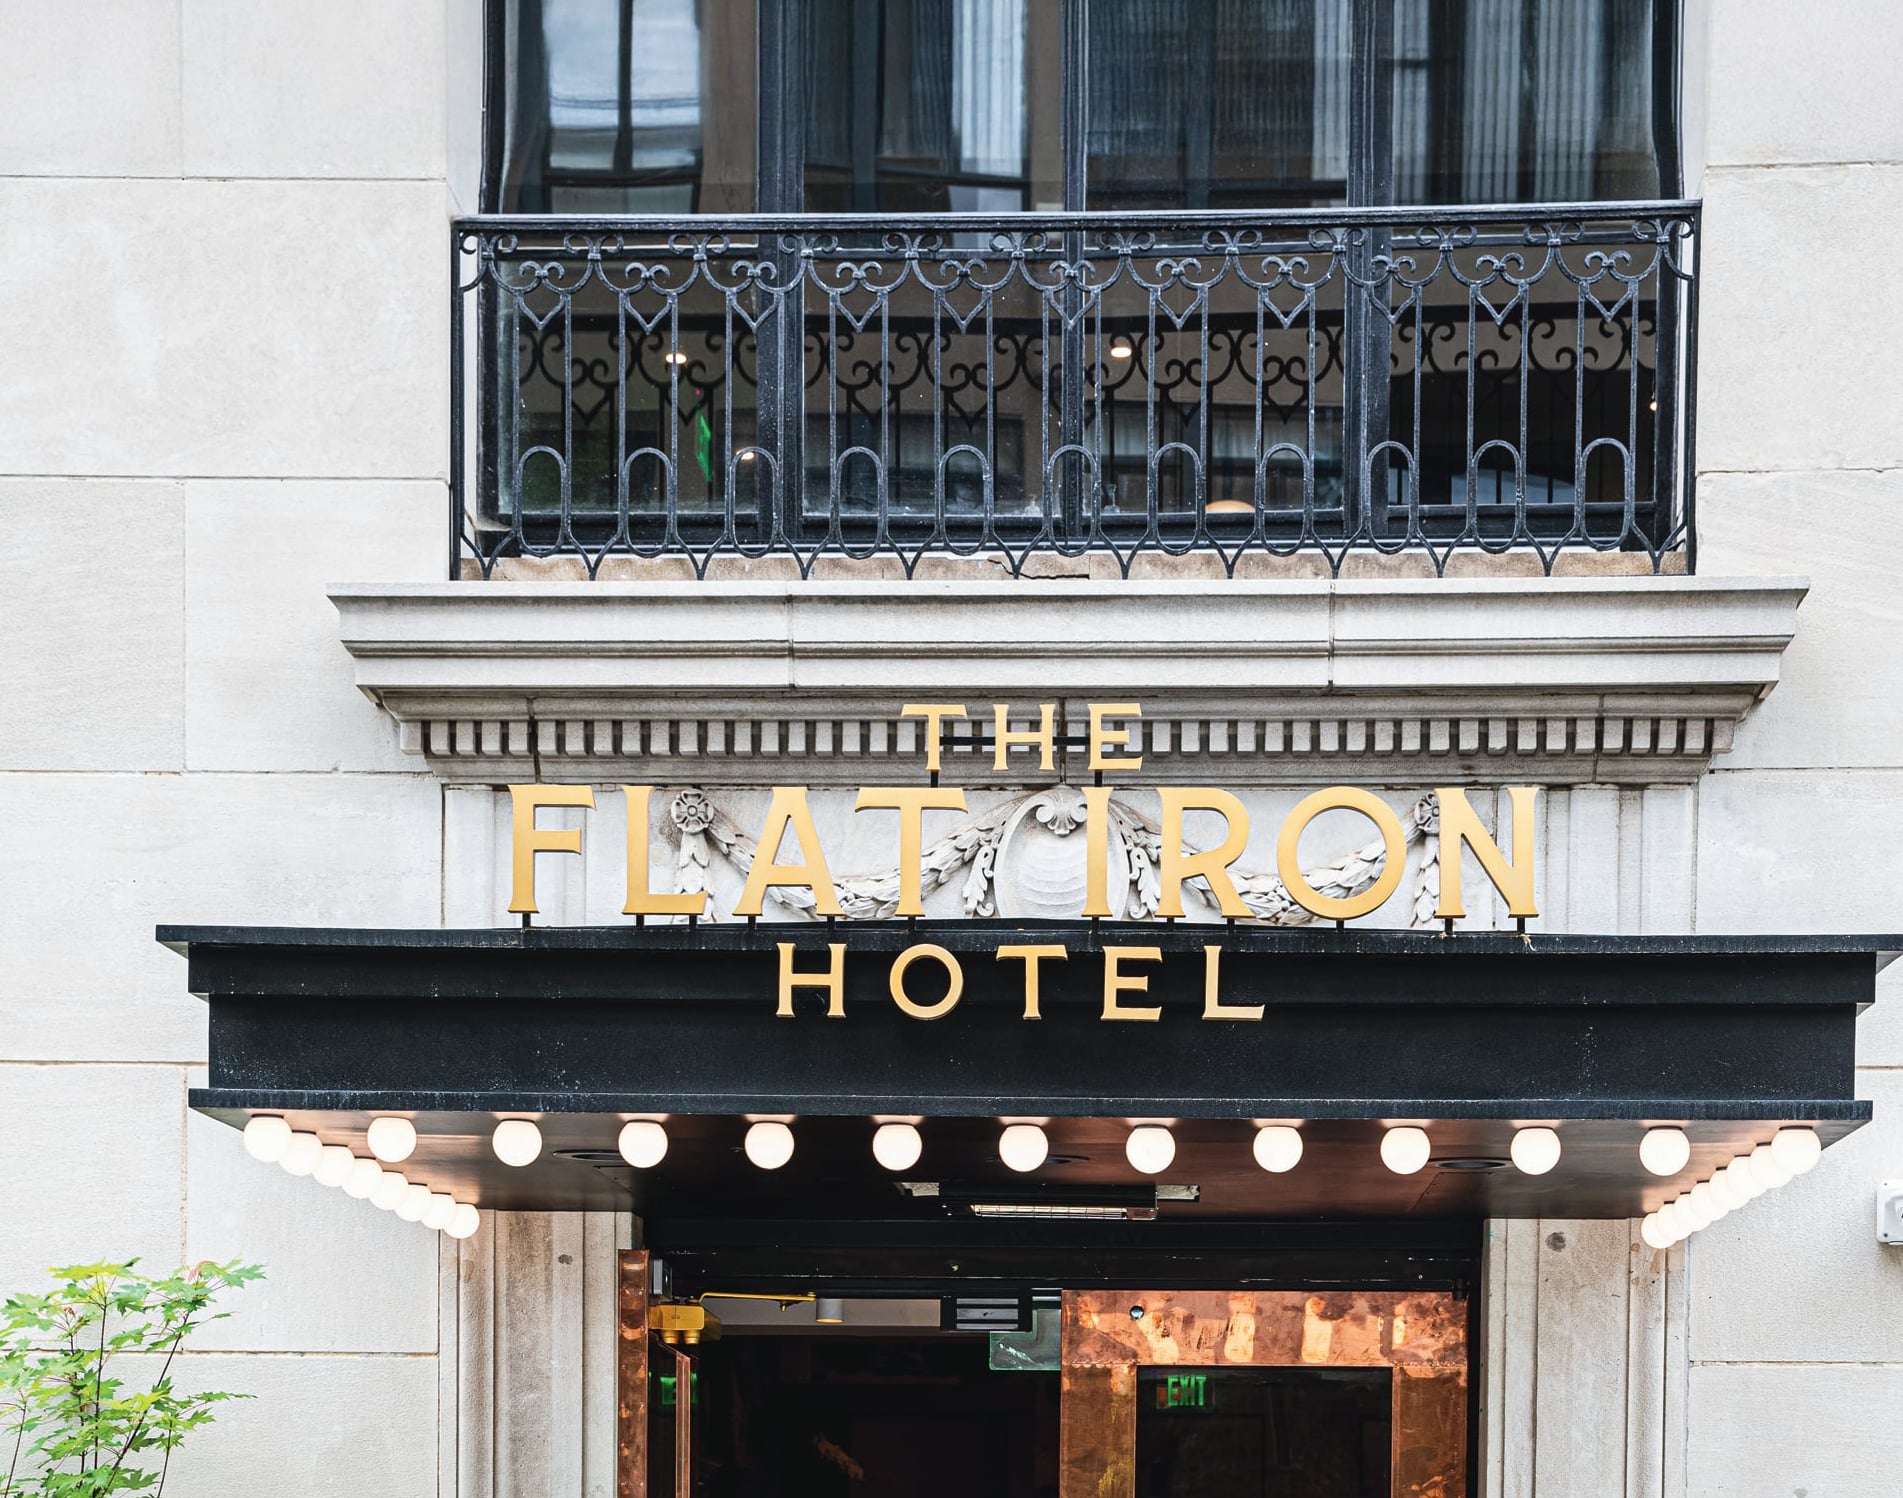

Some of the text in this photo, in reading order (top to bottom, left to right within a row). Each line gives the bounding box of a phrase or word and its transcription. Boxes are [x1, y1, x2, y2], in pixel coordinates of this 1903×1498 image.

[900, 702, 1144, 773] THE
[506, 783, 1542, 920] FLAT IRON
[775, 942, 1266, 1022] HOTEL
[1168, 1374, 1207, 1407] EXIT
